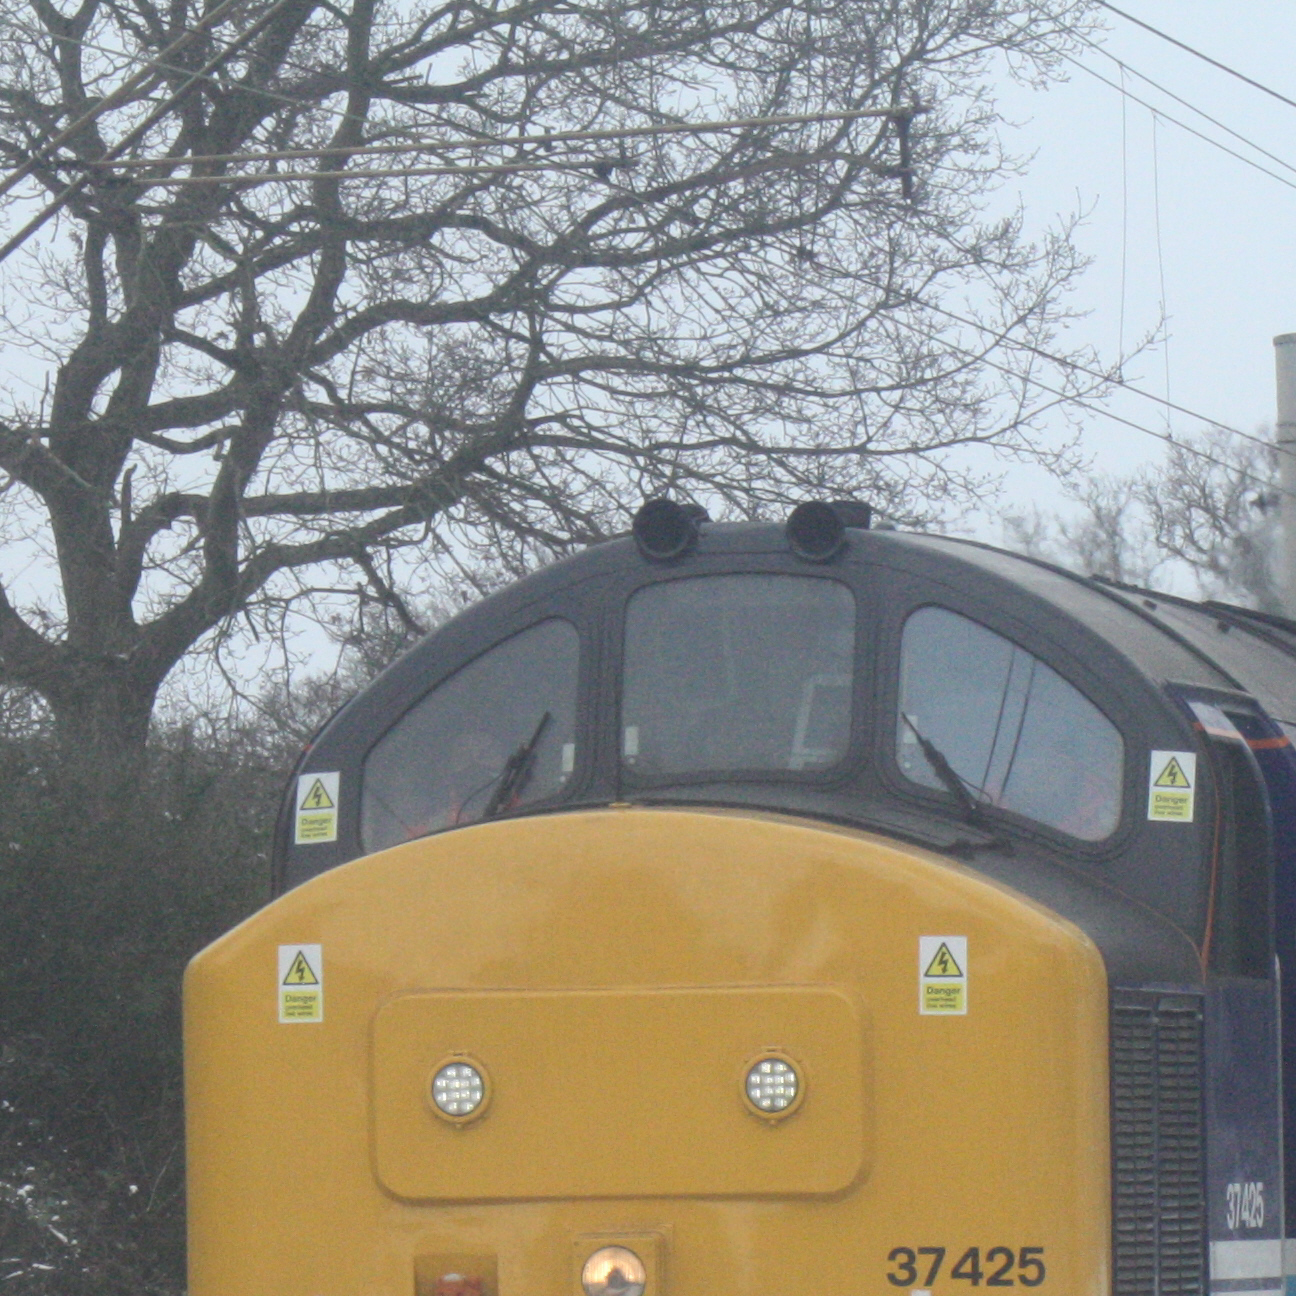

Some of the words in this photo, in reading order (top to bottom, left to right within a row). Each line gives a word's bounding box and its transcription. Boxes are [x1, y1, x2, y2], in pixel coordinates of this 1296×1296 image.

[1155, 794, 1188, 805] Danger
[301, 818, 332, 827] Danger
[926, 986, 961, 997] Danger
[285, 994, 317, 1004] Danger
[1226, 1182, 1264, 1229] 37425
[886, 1246, 1046, 1287] 37425
